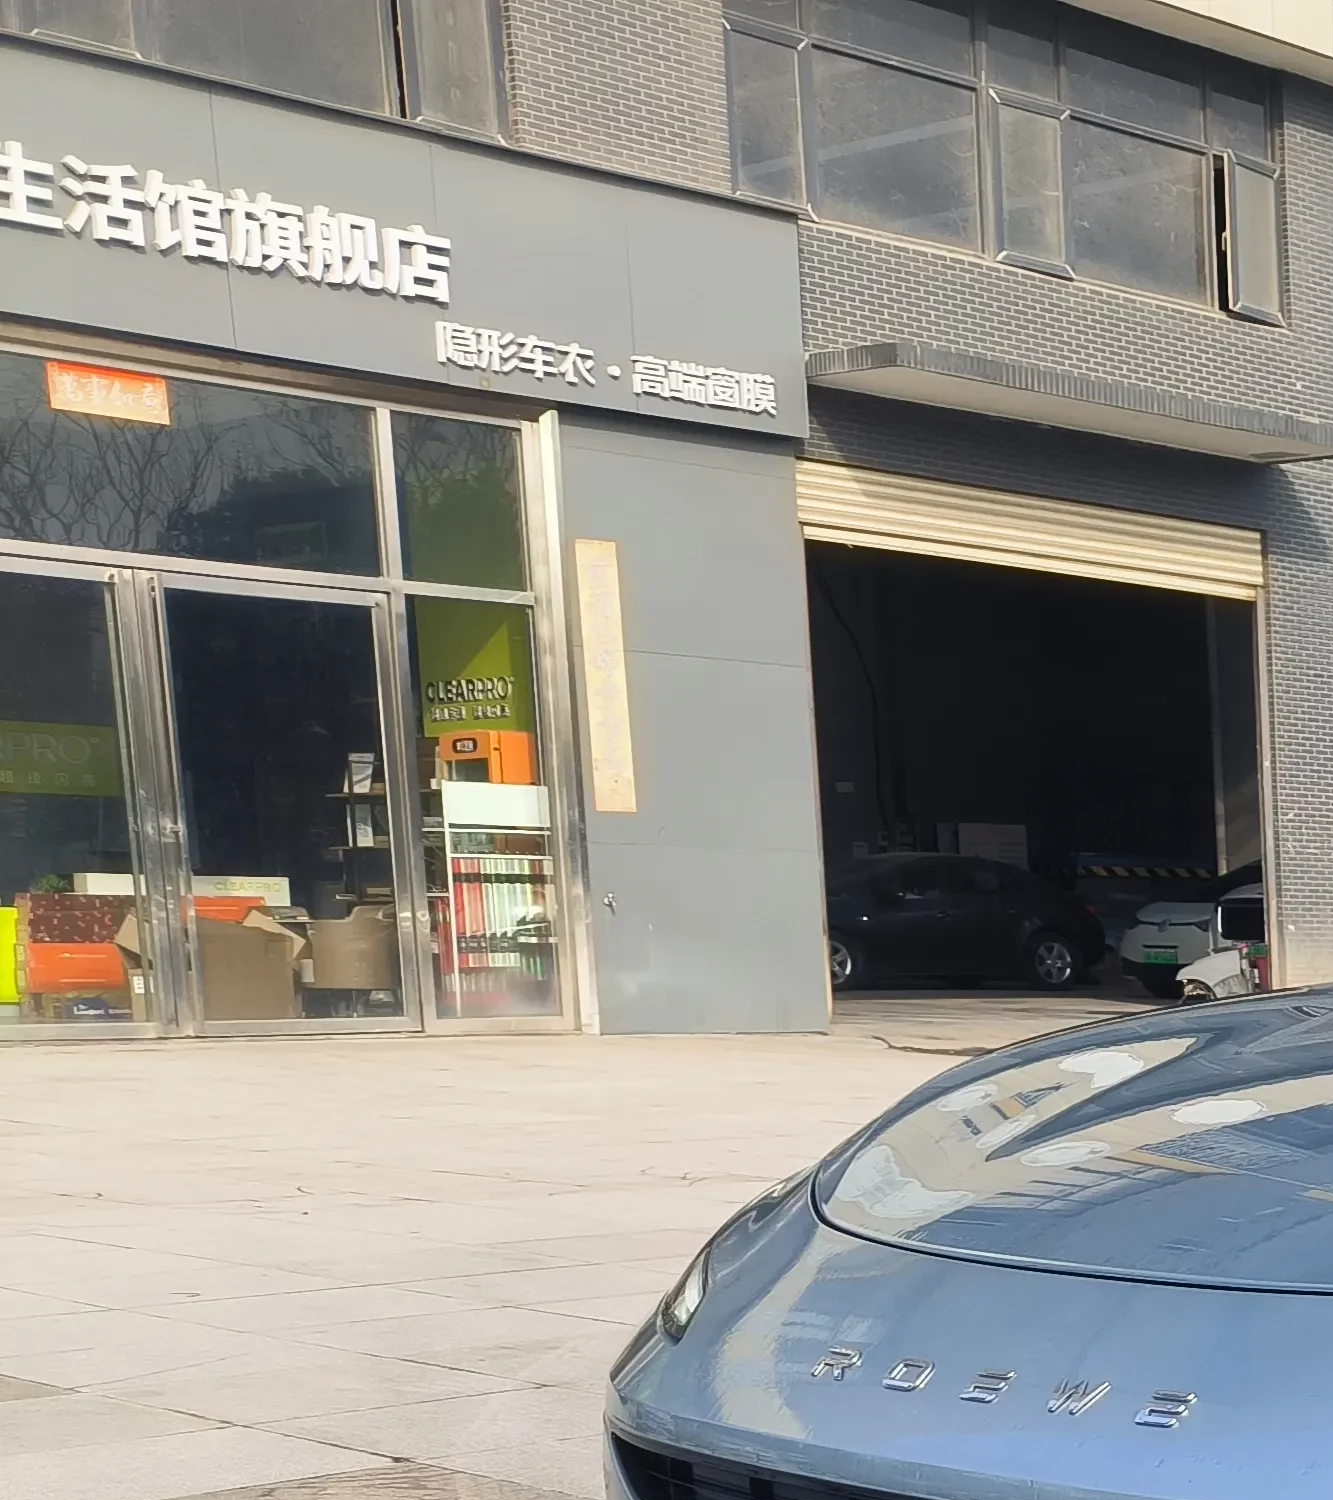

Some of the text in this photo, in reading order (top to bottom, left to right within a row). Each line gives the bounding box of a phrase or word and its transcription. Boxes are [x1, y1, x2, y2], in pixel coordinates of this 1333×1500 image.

[0, 141, 450, 304] 生活馆旗舰店
[434, 321, 776, 416] 隐形车衣 高端窗膜
[425, 676, 510, 702] CLEARPRO
[811, 1344, 1198, 1428] ROEWE
